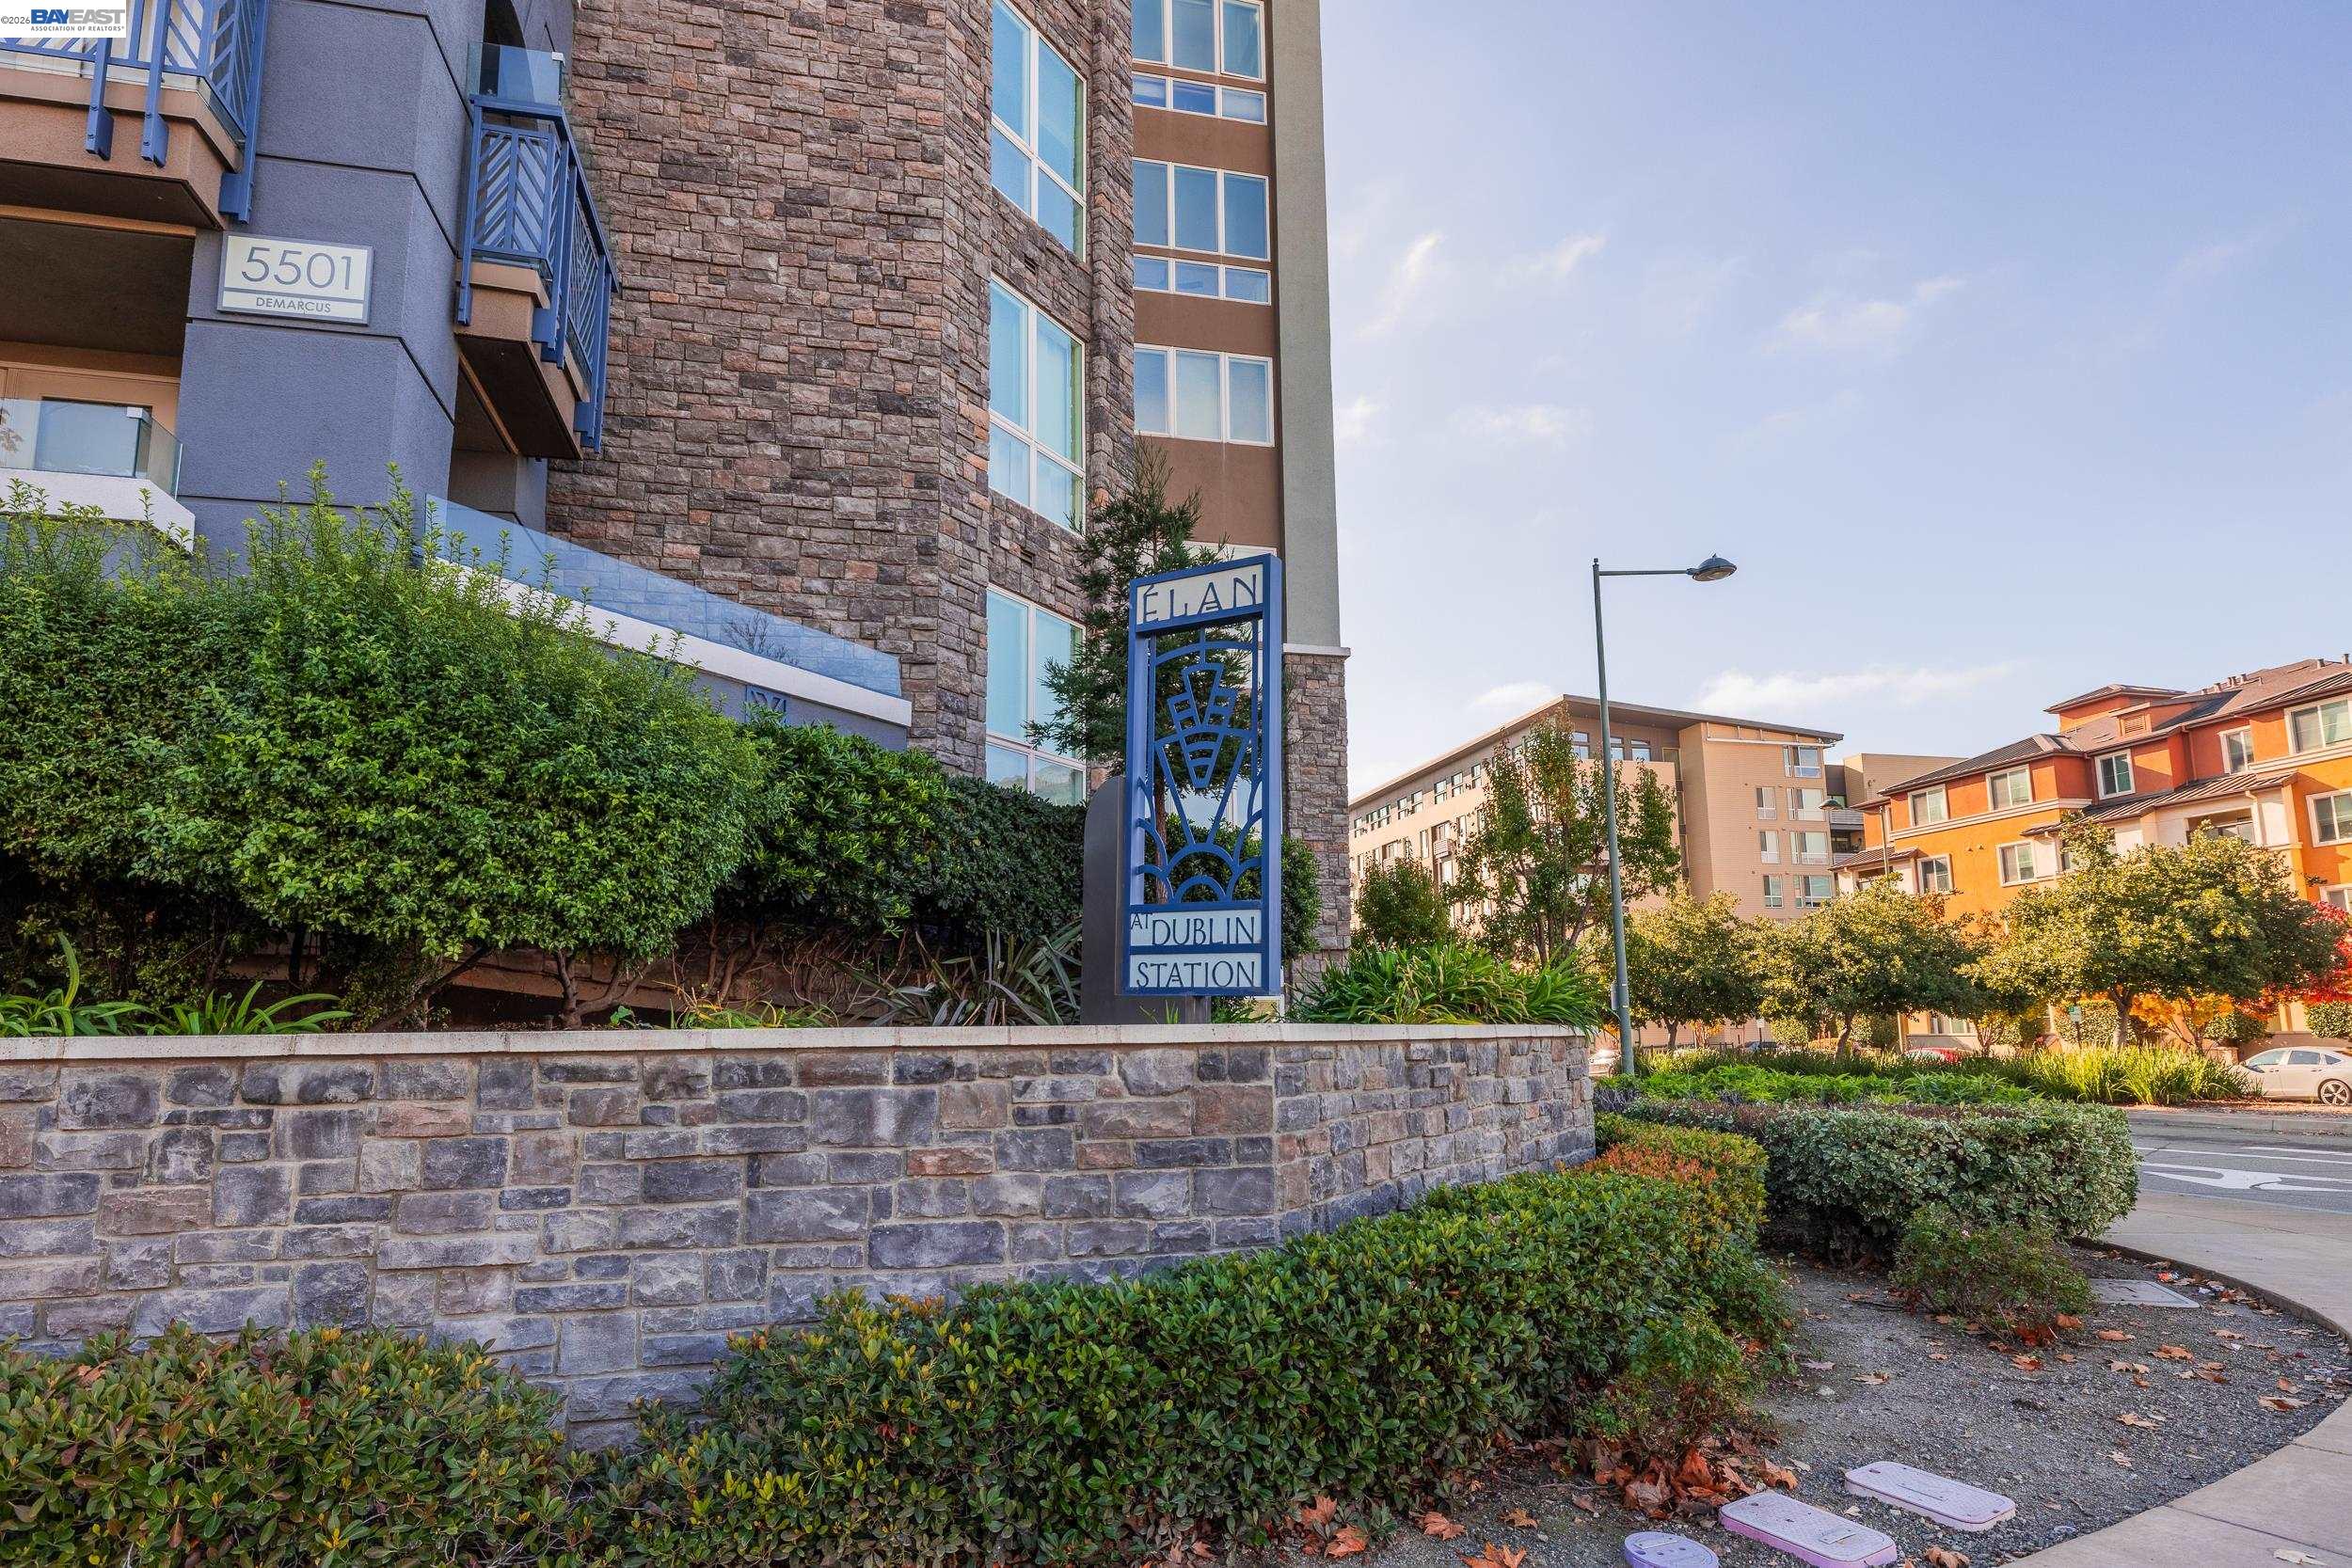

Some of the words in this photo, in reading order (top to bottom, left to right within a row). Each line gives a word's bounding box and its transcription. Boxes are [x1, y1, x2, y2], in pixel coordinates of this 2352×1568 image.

[241, 246, 353, 290] 5501
[256, 296, 331, 313] DEMARCUS
[1130, 912, 1152, 930] AT
[1151, 916, 1255, 946] DUBLIN
[1136, 960, 1255, 989] STATION
